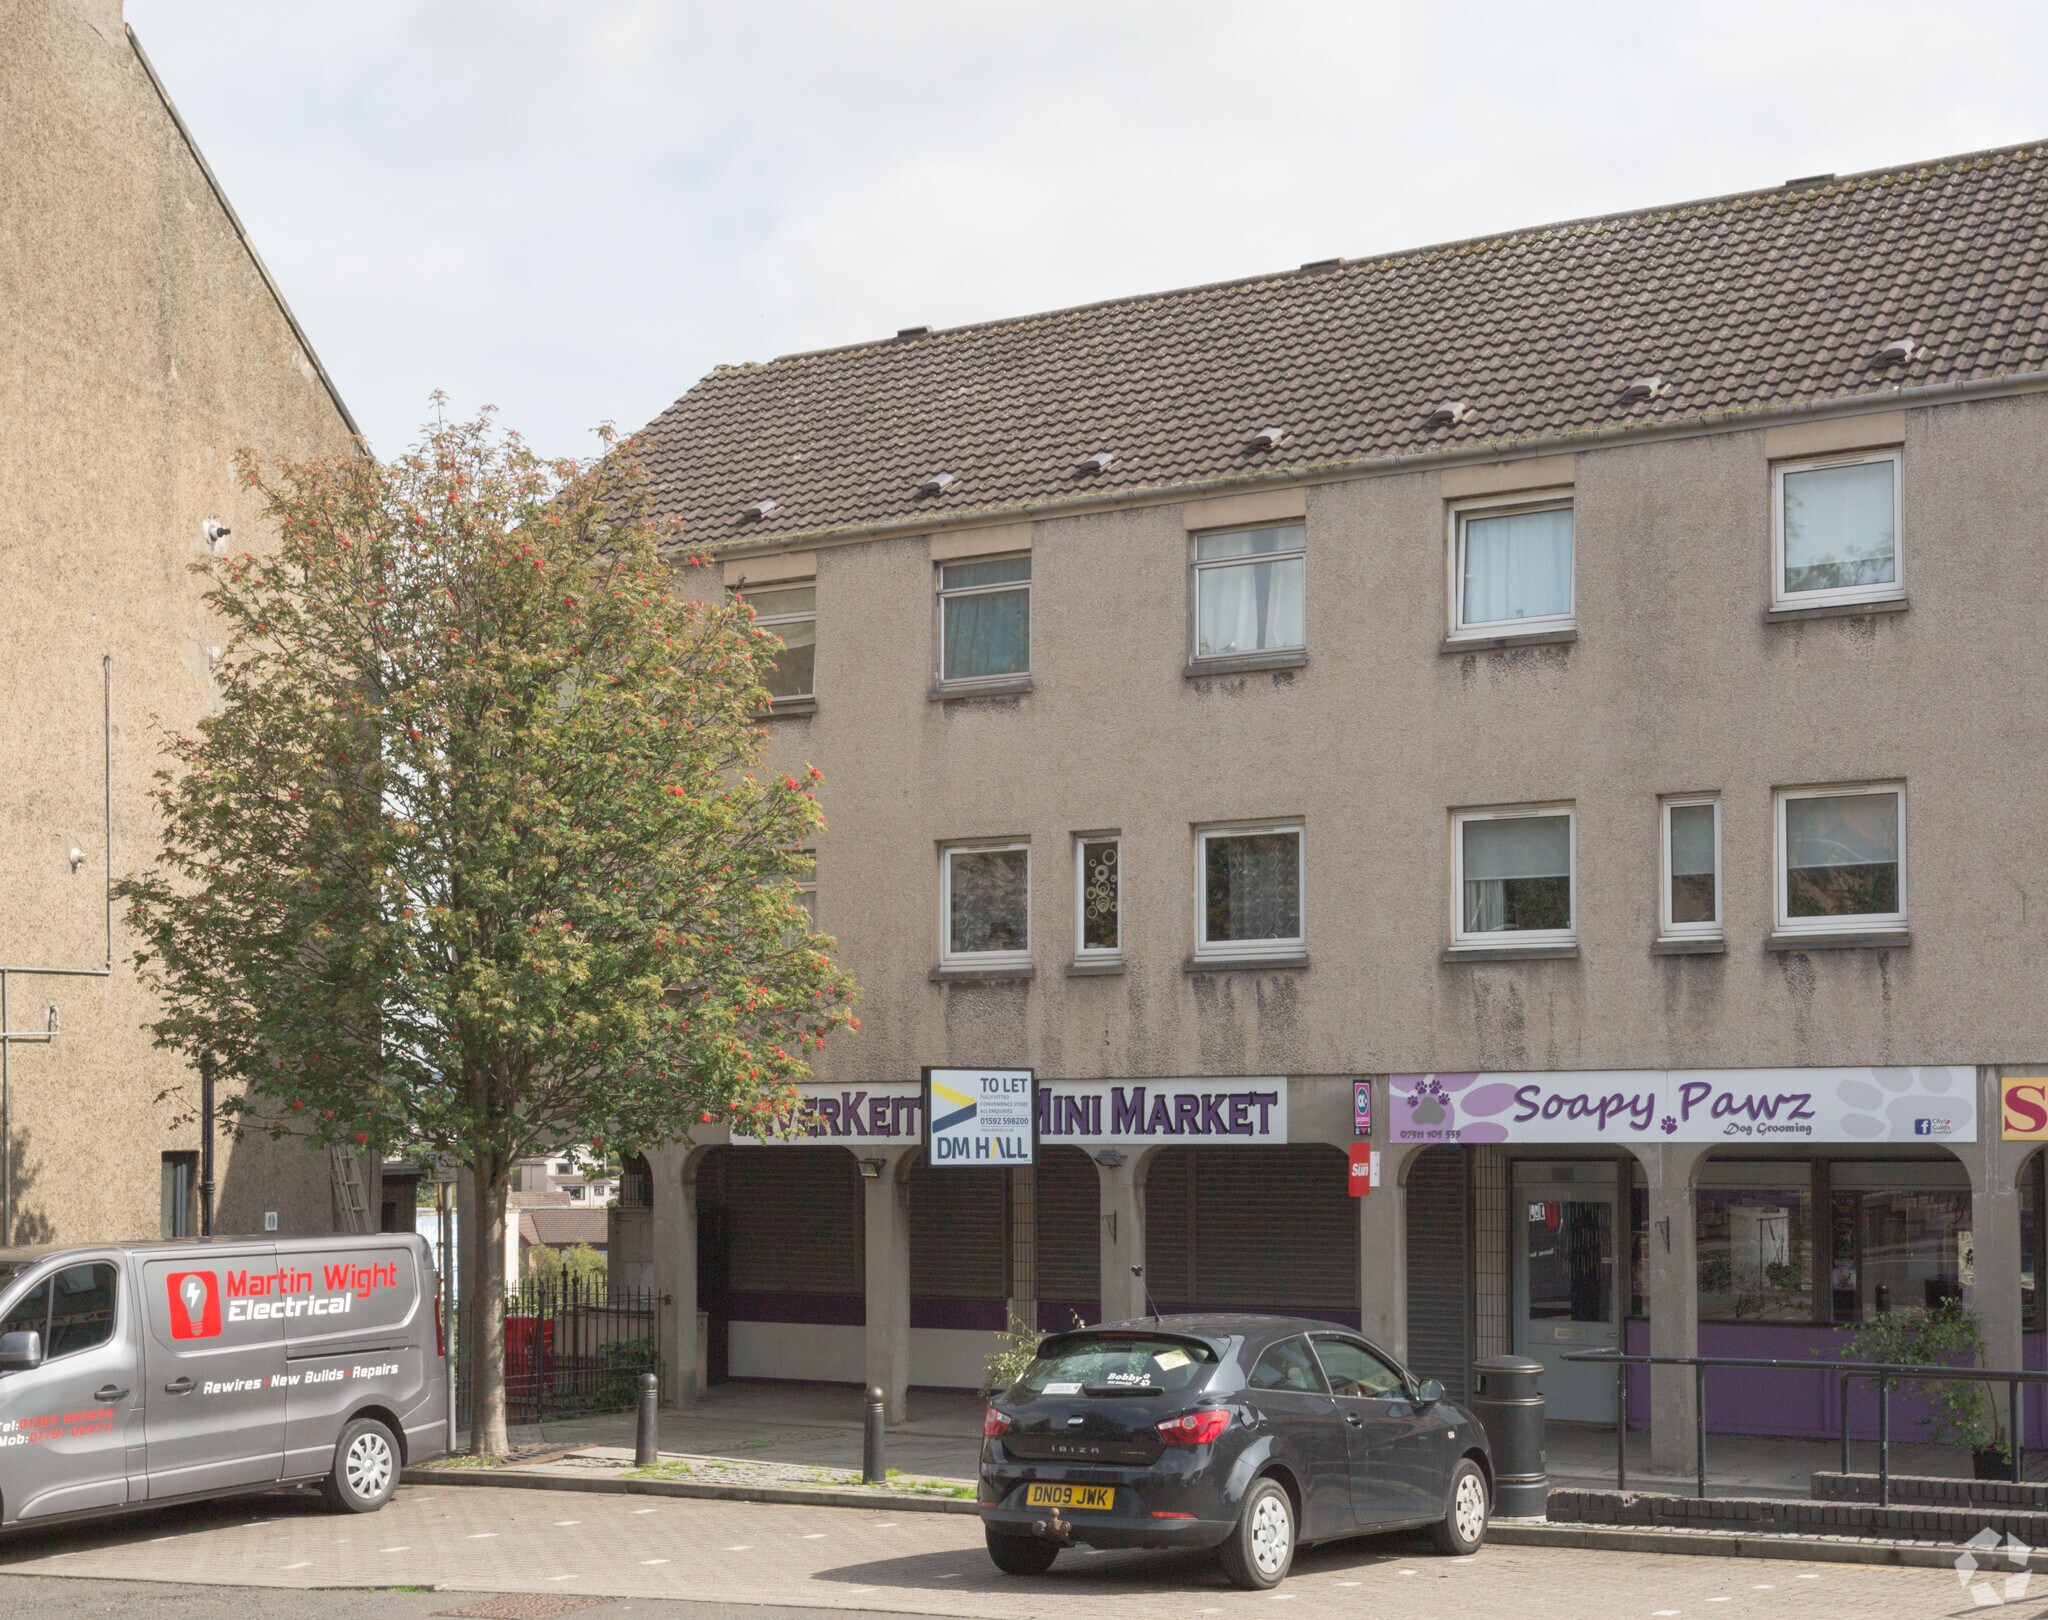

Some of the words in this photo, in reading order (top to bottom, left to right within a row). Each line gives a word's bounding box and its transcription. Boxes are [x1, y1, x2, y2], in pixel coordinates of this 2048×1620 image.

[980, 1078, 999, 1092] TO
[1003, 1078, 1028, 1092] LET
[1111, 1086, 1277, 1136] MARKET
[1513, 1085, 1654, 1131] Soapy
[1678, 1082, 1815, 1121] Pawz
[980, 1117, 1001, 1125] 01592
[1003, 1117, 1029, 1125] 598200
[1723, 1122, 1753, 1136] Dog
[1756, 1122, 1812, 1136] Grooming
[937, 1137, 970, 1159] DM
[975, 1137, 1028, 1159] HALL
[1351, 1163, 1368, 1177] Sun
[226, 1267, 312, 1298] Martin
[324, 1262, 397, 1298] Wight
[228, 1293, 352, 1321] Electrical
[203, 1379, 262, 1395] Rewires
[271, 1374, 300, 1387] New
[304, 1368, 344, 1383] Builds
[352, 1364, 399, 1379] Repairs
[1107, 1373, 1142, 1383] Bobby
[1051, 1445, 1100, 1454] IBIZA
[1033, 1486, 1073, 1503] DN09
[1076, 1488, 1108, 1506] JWK
